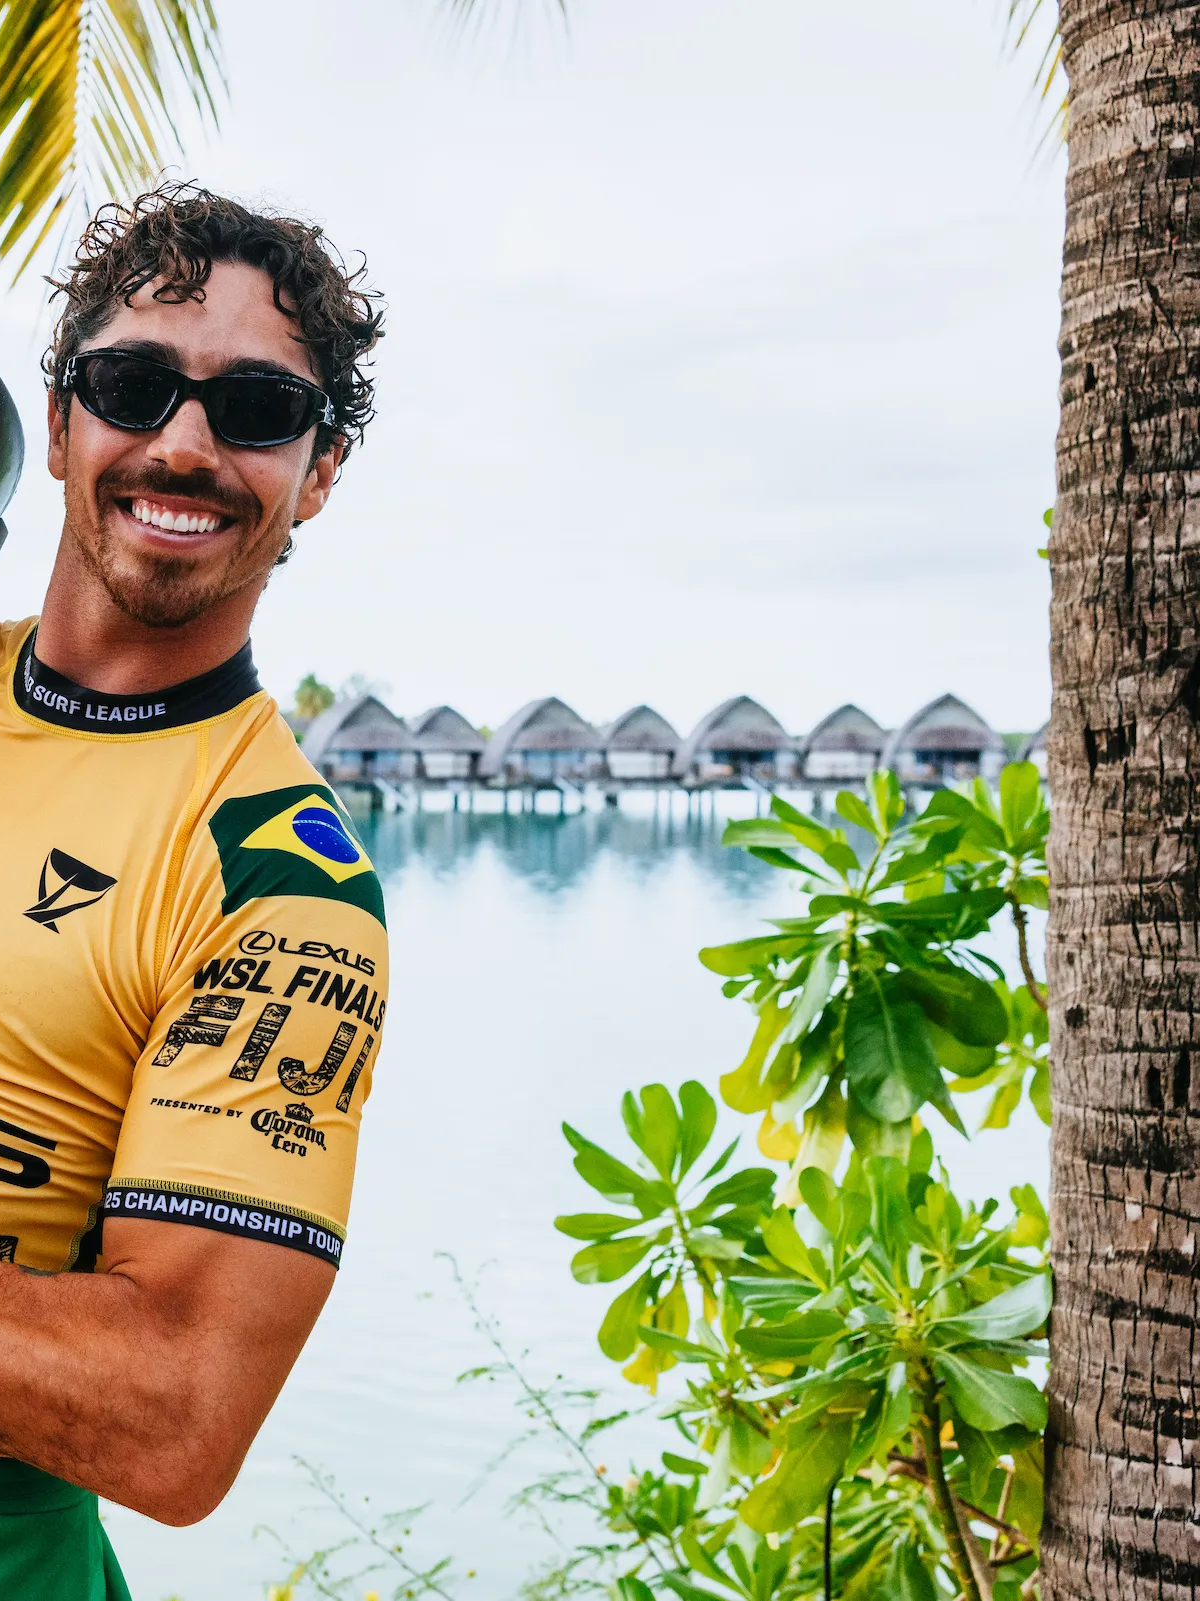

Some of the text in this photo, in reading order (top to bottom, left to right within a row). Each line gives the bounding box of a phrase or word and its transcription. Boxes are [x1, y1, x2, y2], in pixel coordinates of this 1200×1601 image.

[33, 685, 167, 722] SURF LEAGUE
[278, 937, 376, 977] LEXUS
[193, 958, 387, 1033] WSL FINALS
[151, 994, 374, 1113] FIJI
[150, 1097, 243, 1118] PRESENTED BY
[250, 1108, 327, 1151] Corona
[271, 1133, 307, 1157] Cero
[124, 1191, 303, 1239] CHAMPIONSHIP
[307, 1226, 342, 1259] TOUR
